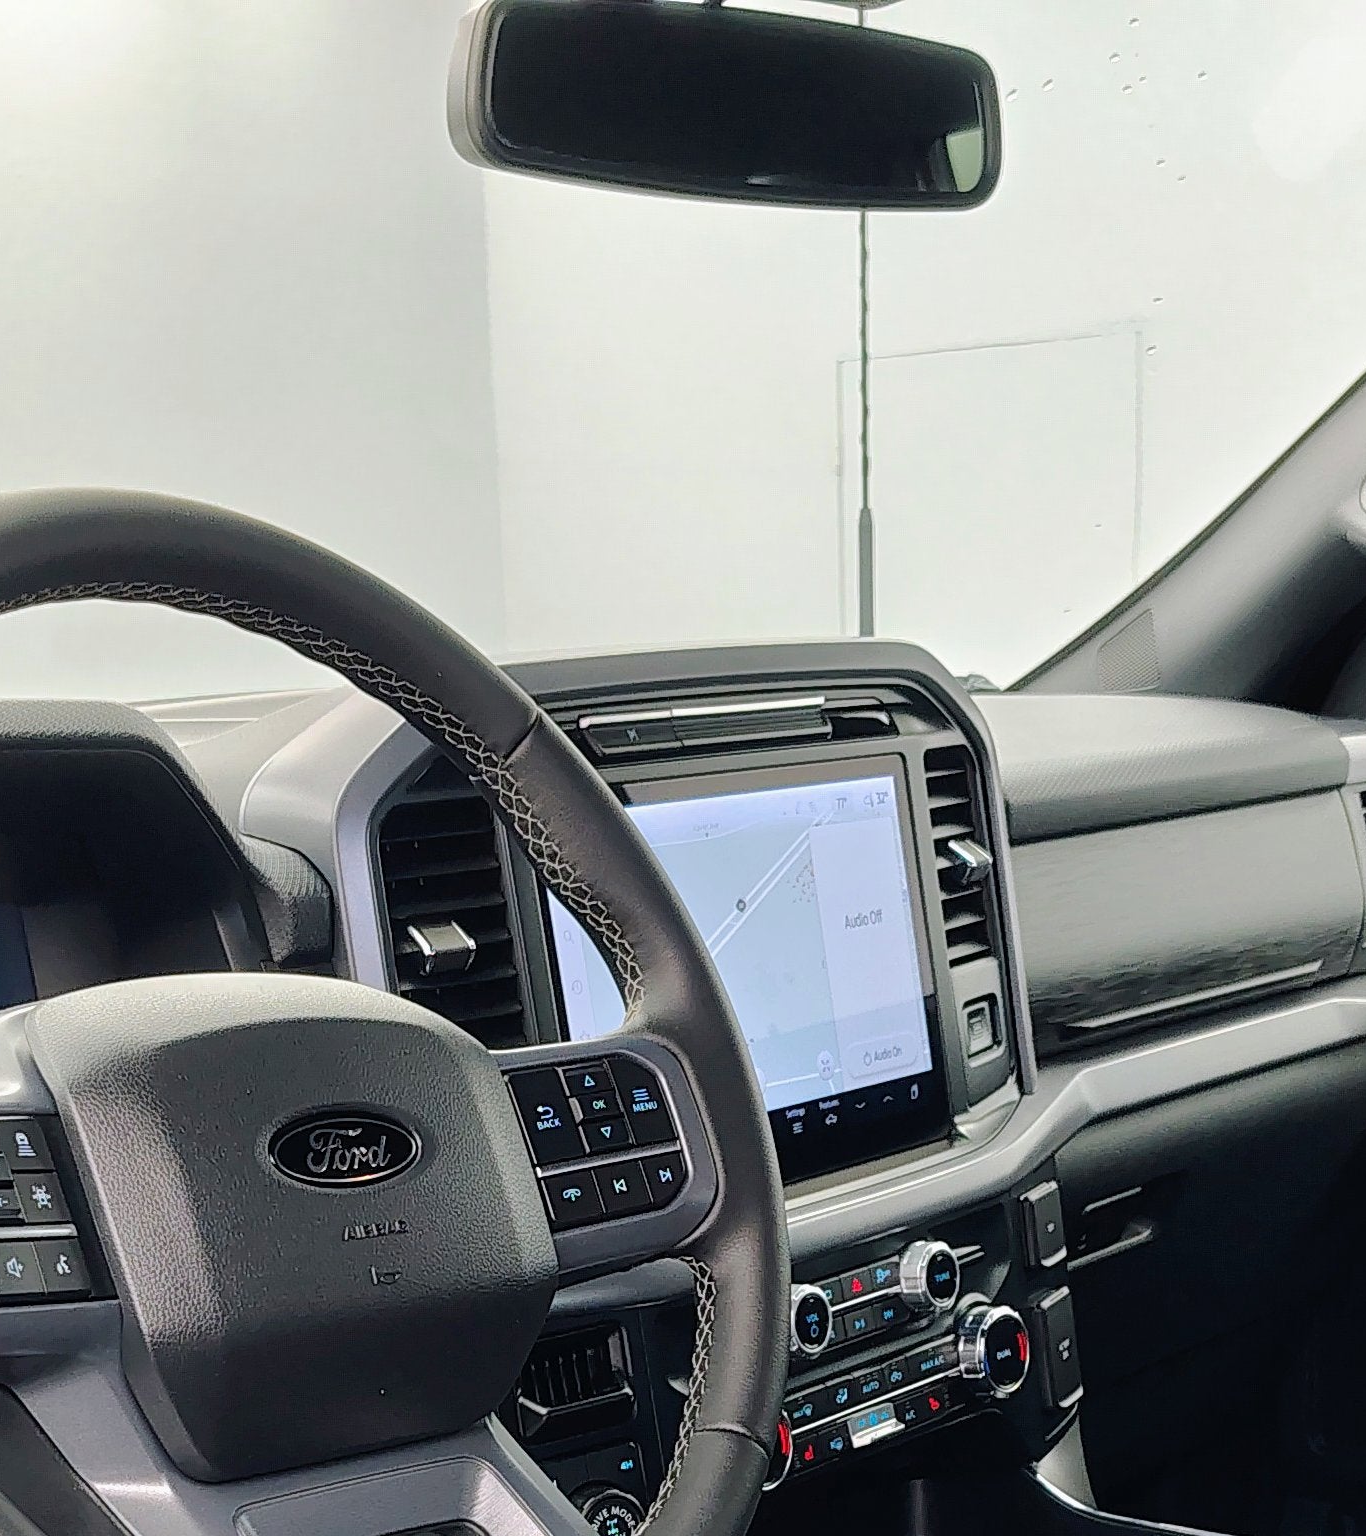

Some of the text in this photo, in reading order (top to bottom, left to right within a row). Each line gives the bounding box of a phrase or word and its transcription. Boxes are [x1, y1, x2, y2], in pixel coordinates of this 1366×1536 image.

[844, 909, 883, 929] Audio Off
[592, 1099, 606, 1110] OK
[632, 1100, 658, 1113] MENU
[536, 1118, 562, 1131] BACK
[306, 1127, 392, 1173] Ford
[342, 1219, 410, 1241] AIRBAG
